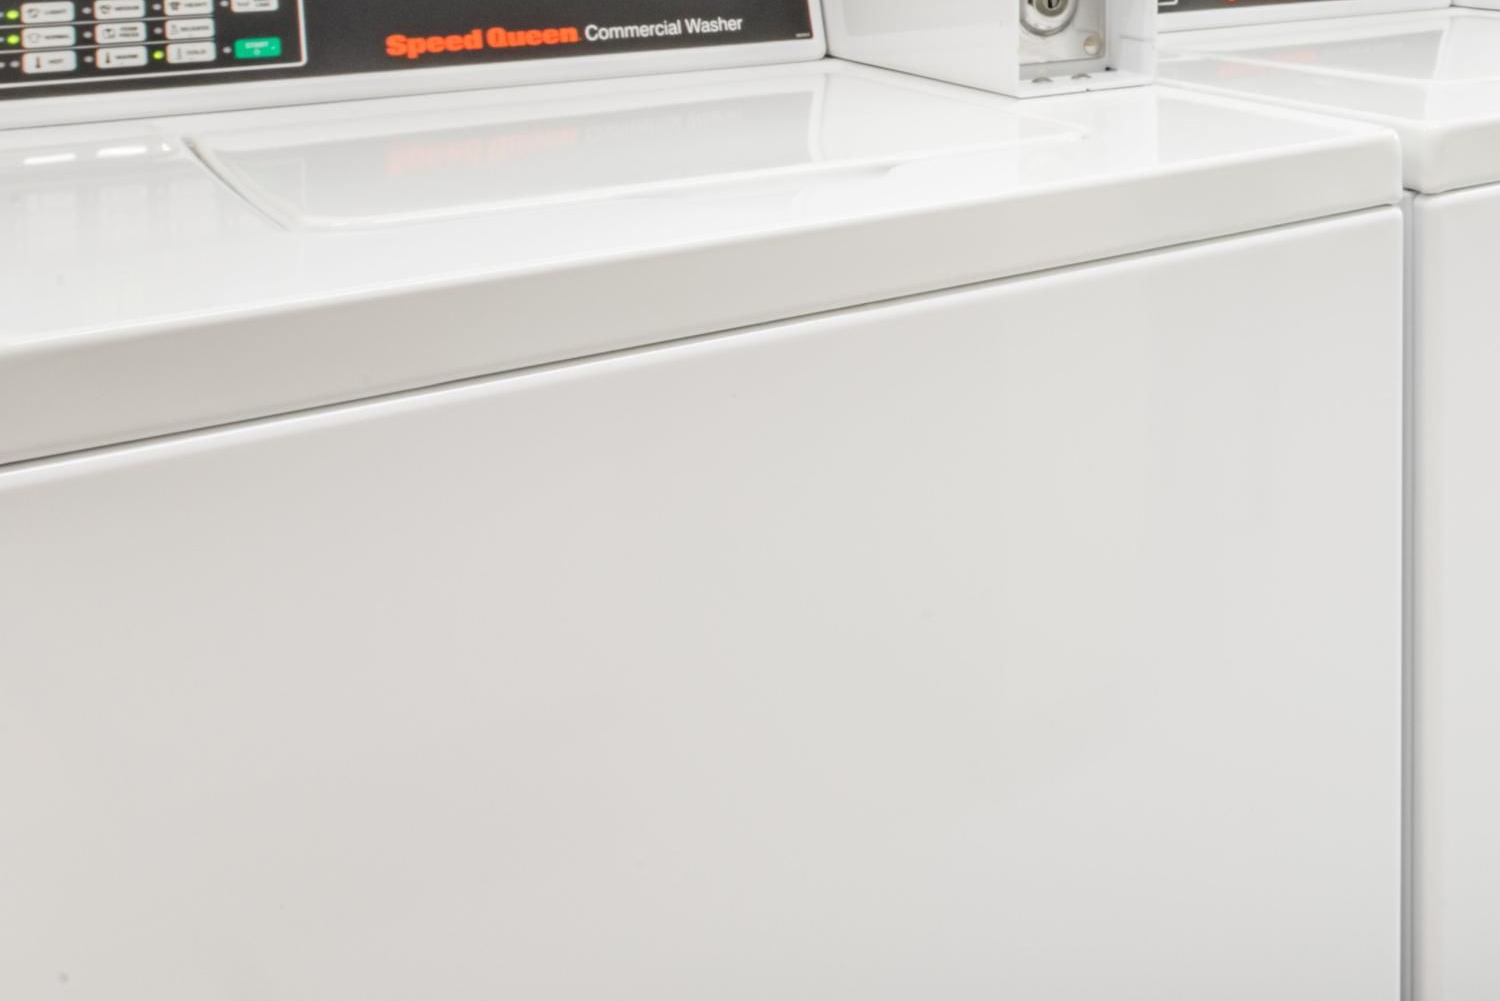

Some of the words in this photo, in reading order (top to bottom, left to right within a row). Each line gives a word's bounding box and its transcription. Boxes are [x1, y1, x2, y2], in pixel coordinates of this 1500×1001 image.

[385, 29, 483, 59] Speed
[486, 26, 580, 48] Queen
[585, 19, 682, 42] Commercial
[684, 15, 743, 35] Washer
